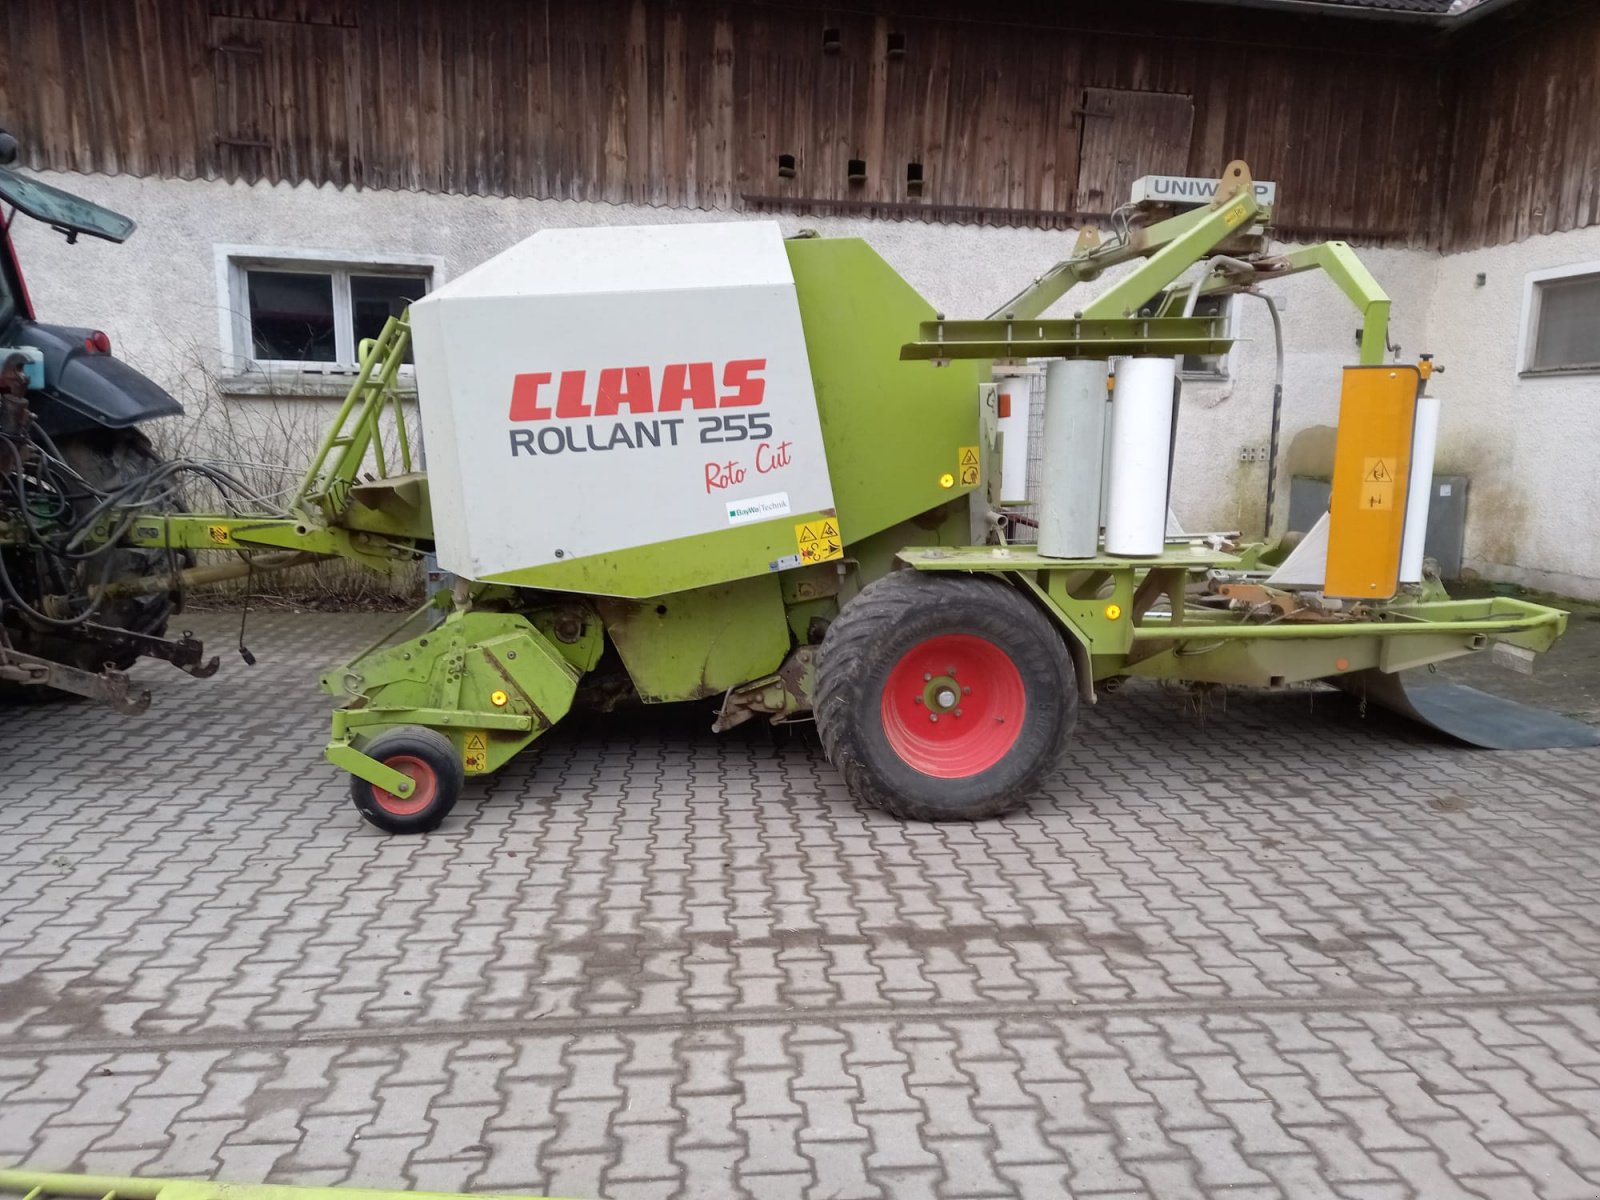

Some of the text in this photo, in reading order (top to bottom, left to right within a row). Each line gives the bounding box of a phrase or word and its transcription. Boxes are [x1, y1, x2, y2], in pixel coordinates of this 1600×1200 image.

[1154, 180, 1269, 196] UNIWP
[509, 358, 767, 421] CLAAS
[509, 412, 773, 457] ROLLANT 255
[704, 441, 793, 494] Roto Cut
